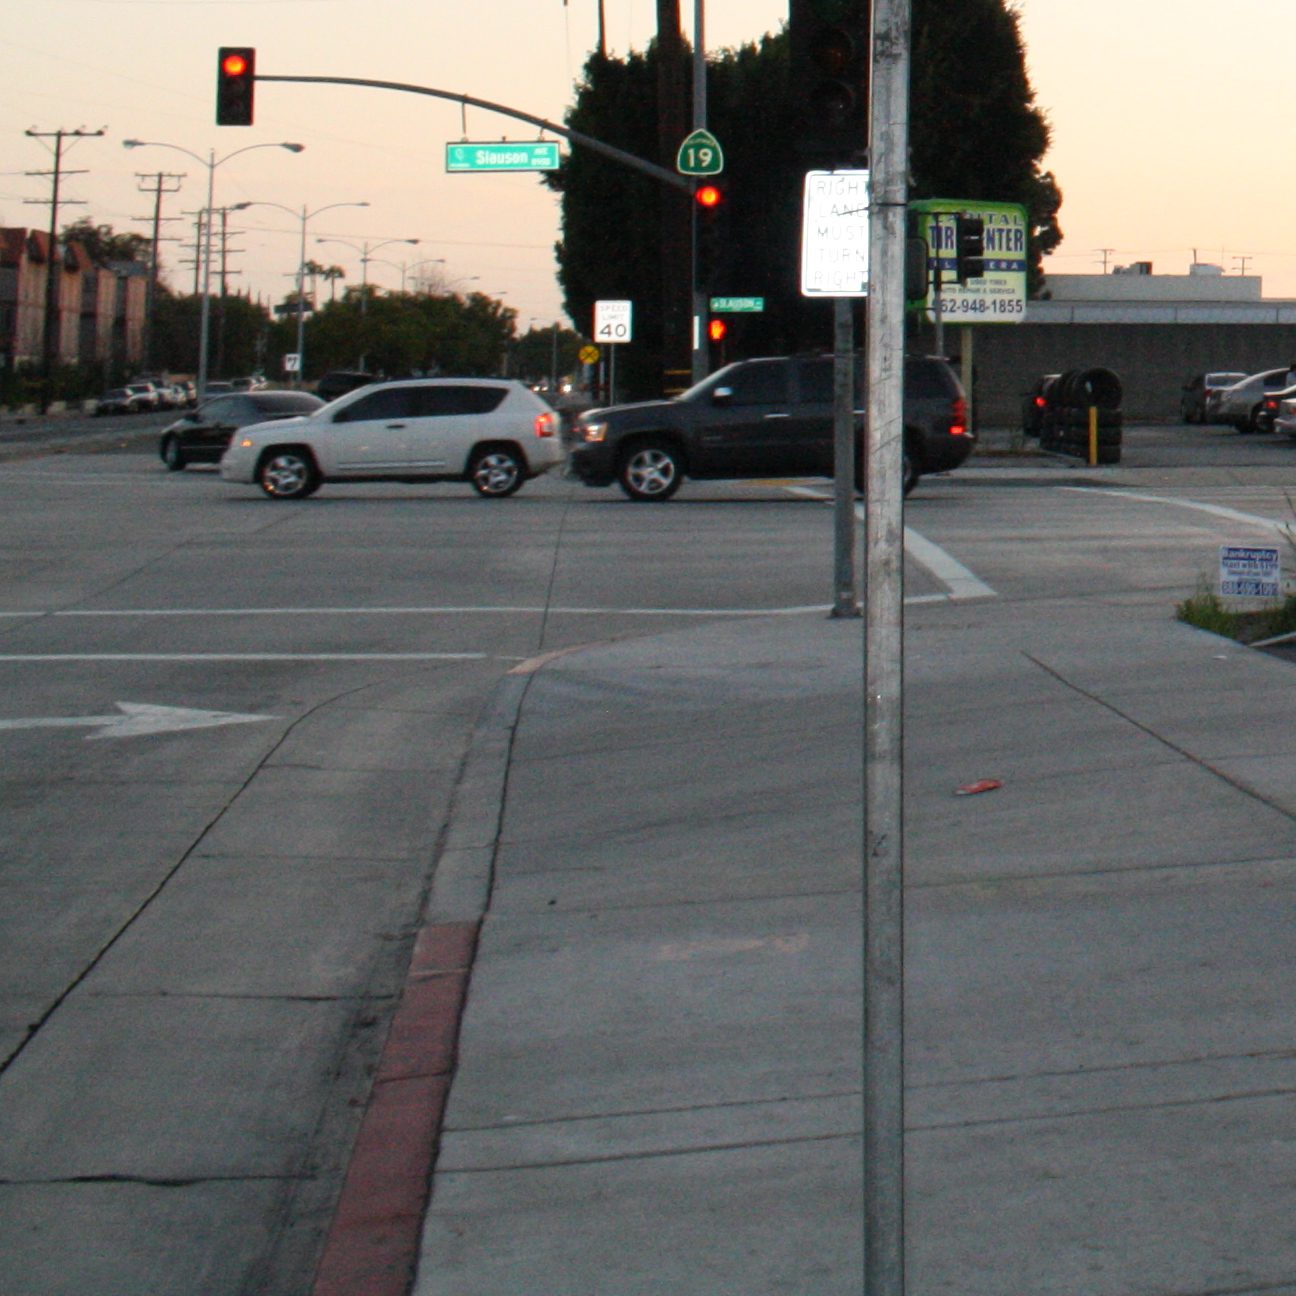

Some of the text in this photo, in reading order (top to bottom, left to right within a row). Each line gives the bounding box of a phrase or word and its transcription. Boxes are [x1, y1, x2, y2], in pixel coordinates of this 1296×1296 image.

[475, 150, 528, 165] Slauson
[687, 147, 713, 168] 19
[819, 203, 865, 218] LANE
[817, 226, 865, 241] MUST
[818, 248, 865, 263] TURN
[599, 323, 627, 338] 40
